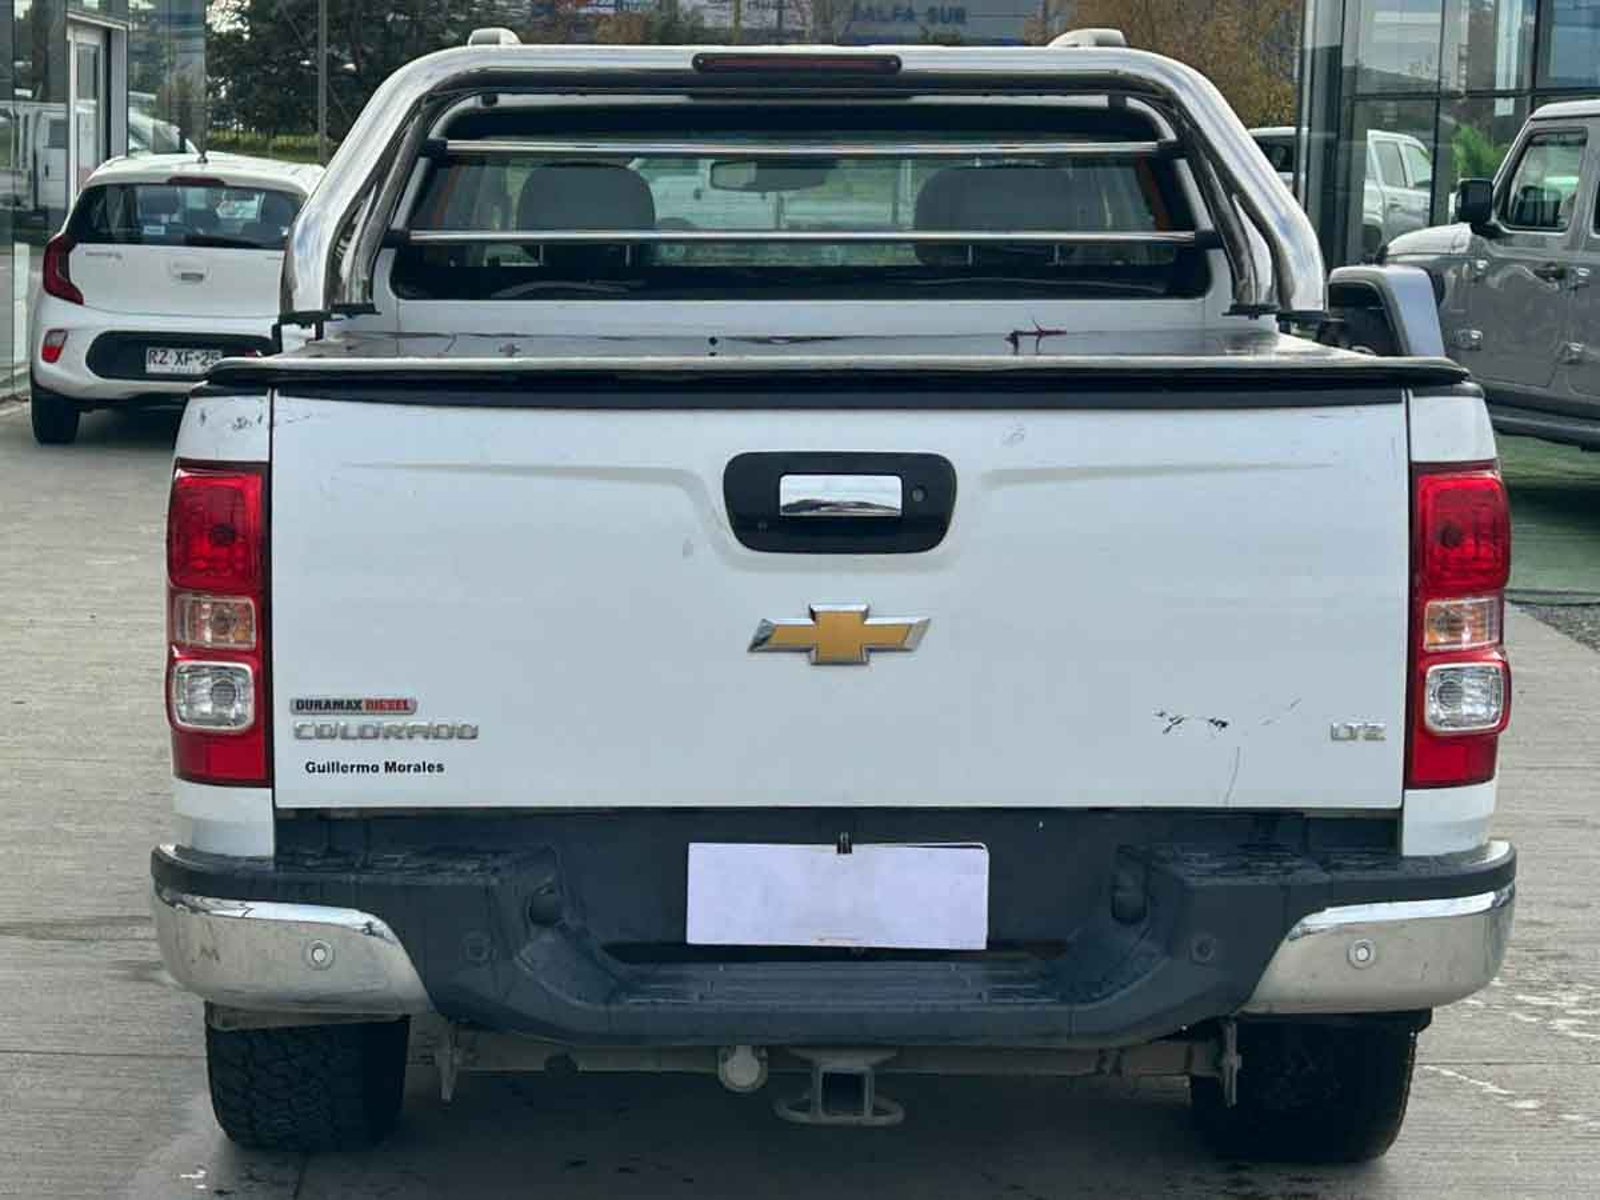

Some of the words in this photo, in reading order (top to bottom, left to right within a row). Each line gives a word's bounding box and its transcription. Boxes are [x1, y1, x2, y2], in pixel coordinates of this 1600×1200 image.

[296, 699, 362, 711] DURAMAX
[364, 699, 410, 711] DIESEL
[294, 722, 478, 740] COLORADO
[305, 761, 380, 773] Guillermo
[384, 761, 445, 773] Morales
